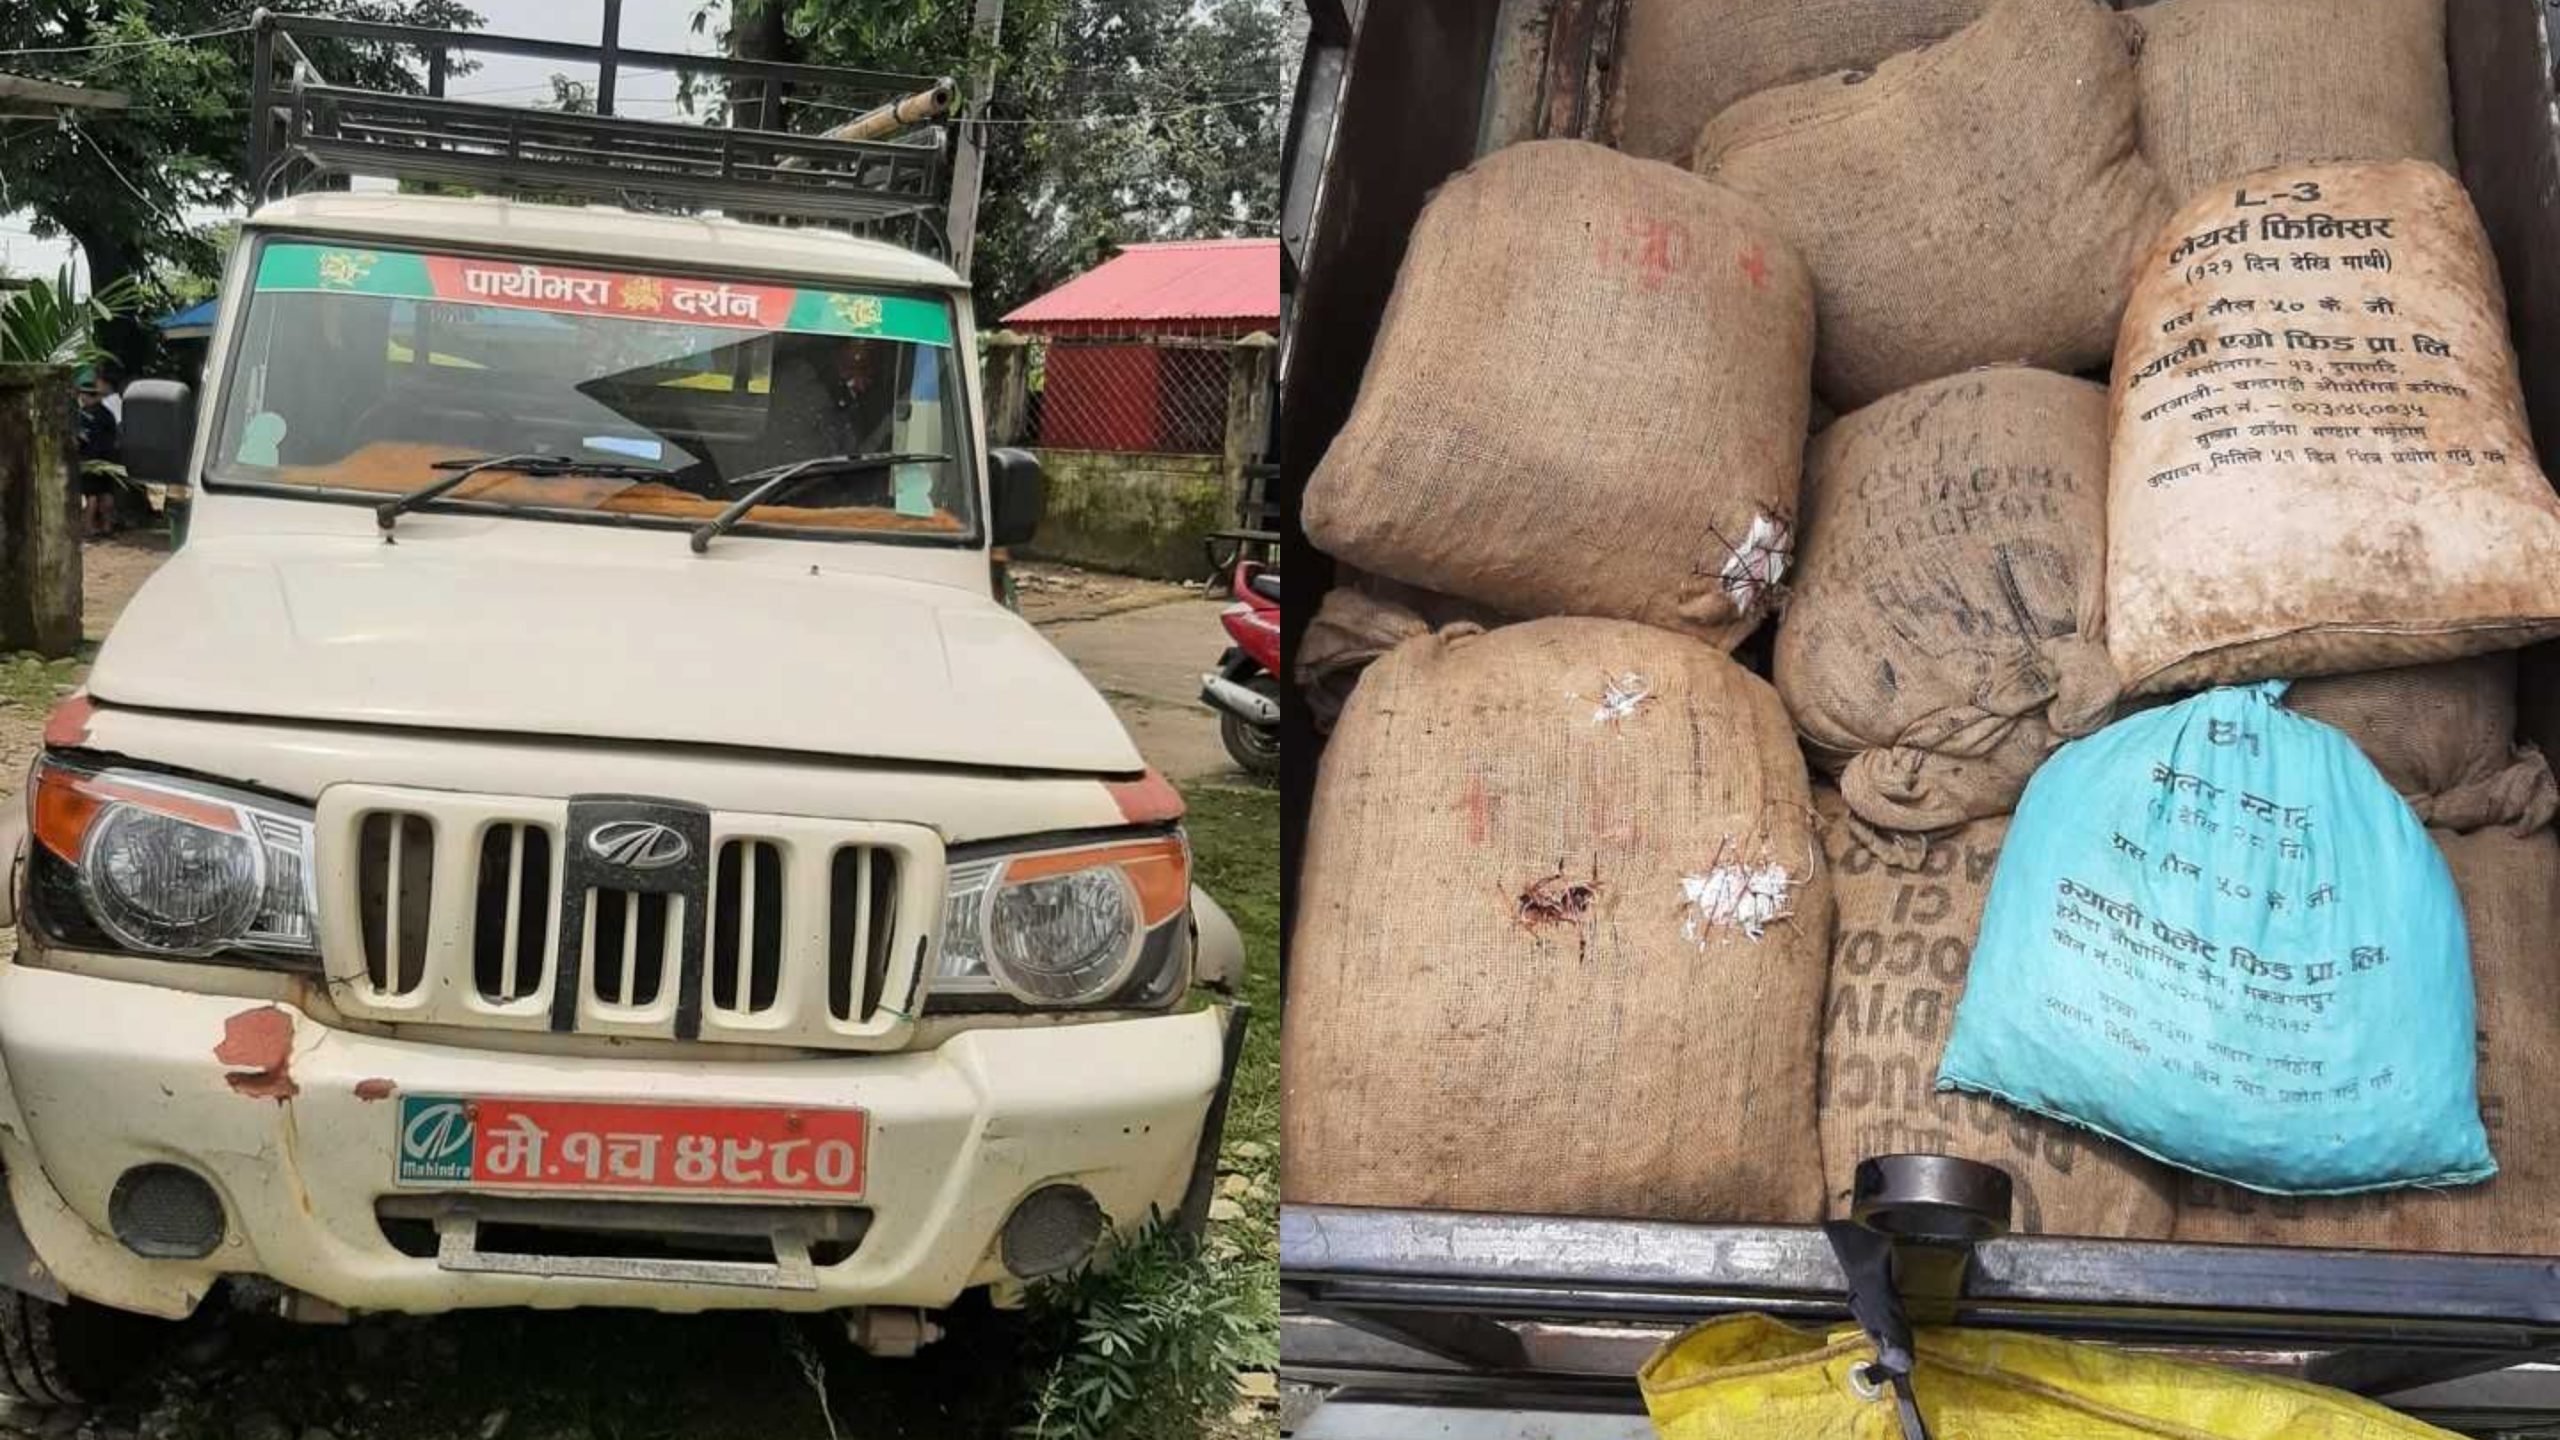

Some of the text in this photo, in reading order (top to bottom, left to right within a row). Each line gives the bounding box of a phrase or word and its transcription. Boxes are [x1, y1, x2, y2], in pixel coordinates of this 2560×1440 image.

[2234, 182, 2321, 208] L-3
[2260, 212, 2395, 241] फिनिसर
[2245, 253, 2280, 272] दिन
[2290, 252, 2330, 272] देखि
[465, 266, 760, 319] पाथीभरा दर्शन
[2284, 329, 2355, 351] फिड
[402, 1161, 472, 1177] Mahindra
